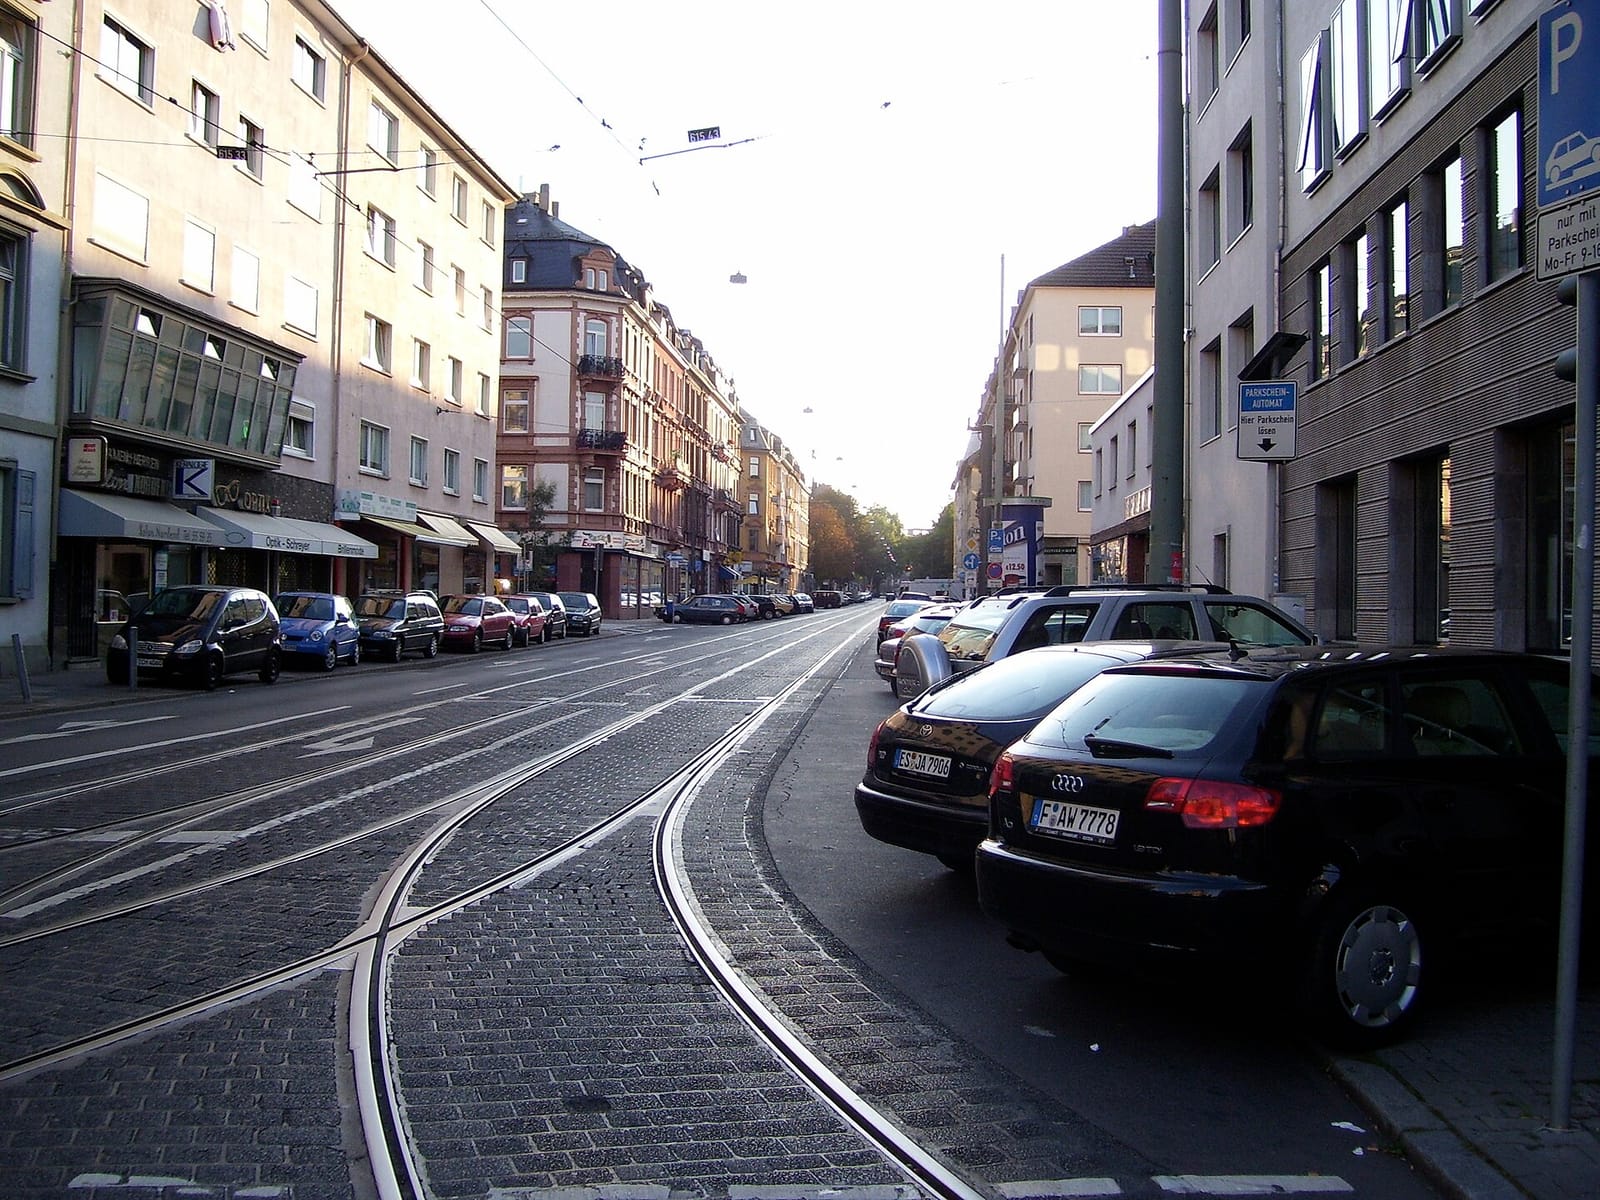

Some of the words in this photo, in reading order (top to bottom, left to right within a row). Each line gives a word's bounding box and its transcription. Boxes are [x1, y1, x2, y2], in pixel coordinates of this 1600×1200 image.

[1551, 11, 1582, 95] P
[690, 132, 706, 142] 615
[218, 149, 233, 159] 615
[235, 150, 246, 160] 33
[1557, 215, 1575, 230] nur
[1579, 204, 1597, 223] mit
[1544, 251, 1577, 272] Mo-Fr
[1245, 387, 1290, 397] PARKSCHEIN-
[1252, 398, 1283, 409] AUTOMAT
[1240, 416, 1255, 425] Hier
[1257, 414, 1295, 424] Parkschein
[1258, 426, 1276, 435] lösen
[265, 535, 281, 549] Optik
[900, 751, 911, 767] ES
[915, 754, 927, 771] JA
[928, 757, 950, 775] 7906
[1039, 803, 1051, 824] F
[1056, 806, 1077, 828] AW
[1078, 809, 1116, 836] 7778
